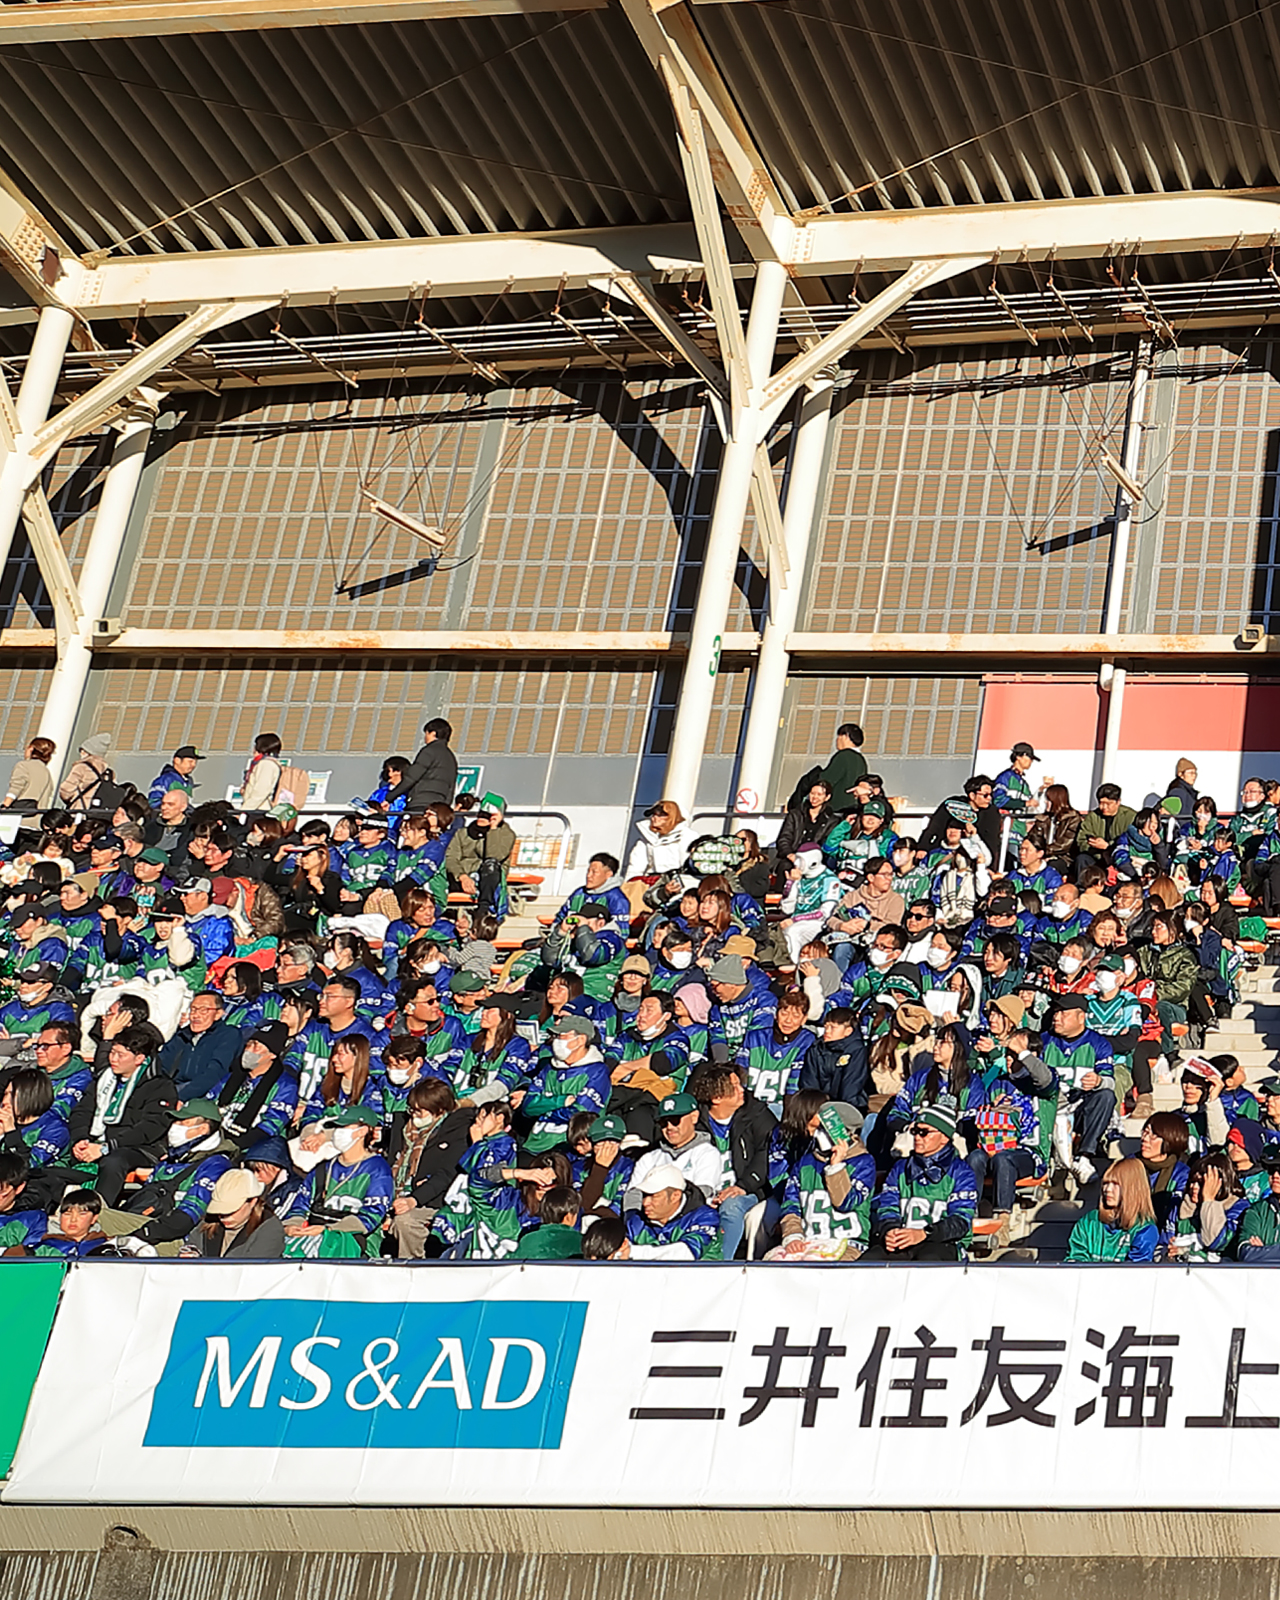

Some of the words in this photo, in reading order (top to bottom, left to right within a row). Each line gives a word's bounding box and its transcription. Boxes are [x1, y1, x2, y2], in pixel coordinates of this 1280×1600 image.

[194, 1335, 547, 1411] MS&AD
[629, 1325, 1280, 1429] 三井住友海上
